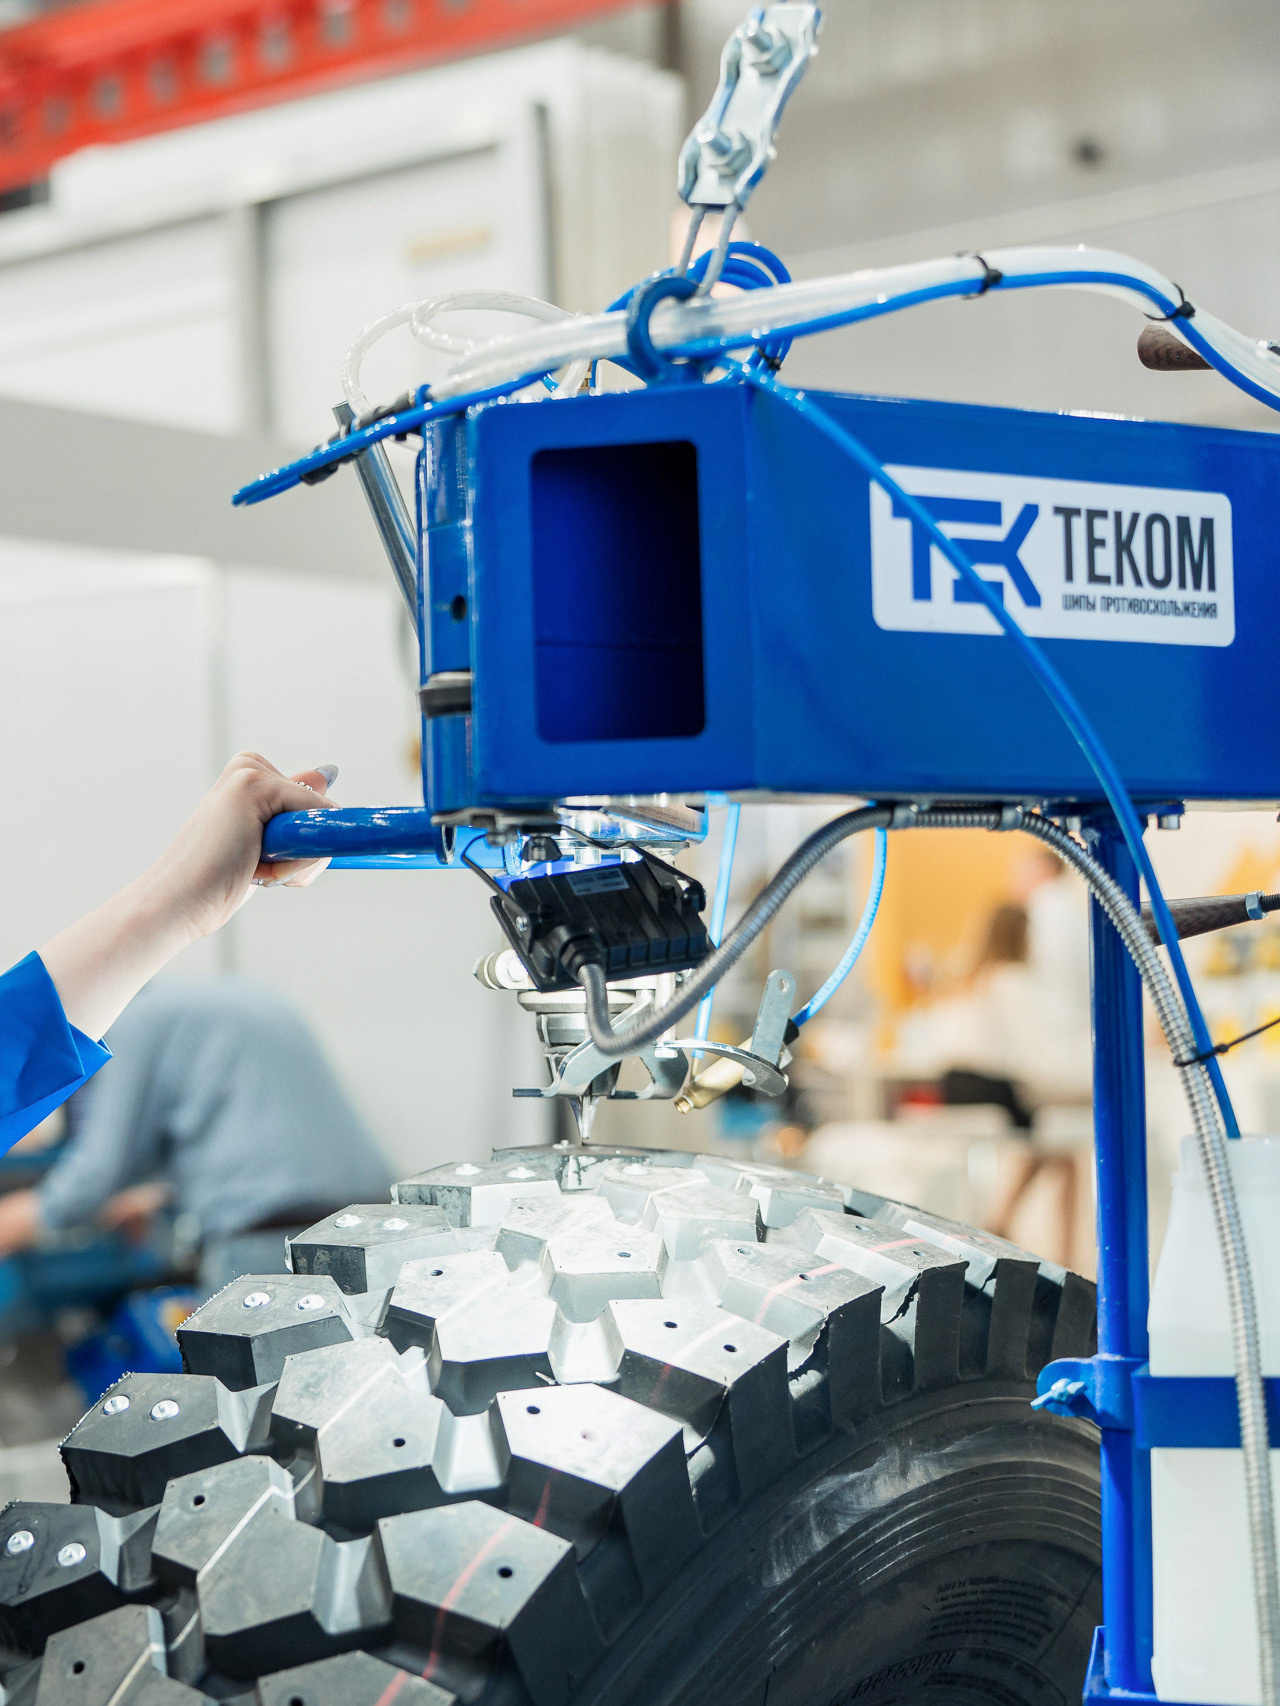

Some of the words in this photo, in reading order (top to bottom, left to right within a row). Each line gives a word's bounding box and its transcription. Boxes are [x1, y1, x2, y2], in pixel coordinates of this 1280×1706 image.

[1053, 505, 1217, 592] ТЕКОМ
[1062, 593, 1097, 612] ШИПЫ
[1100, 596, 1218, 619] ПРОТИВОСКОЛЬЖЕНИЯ
